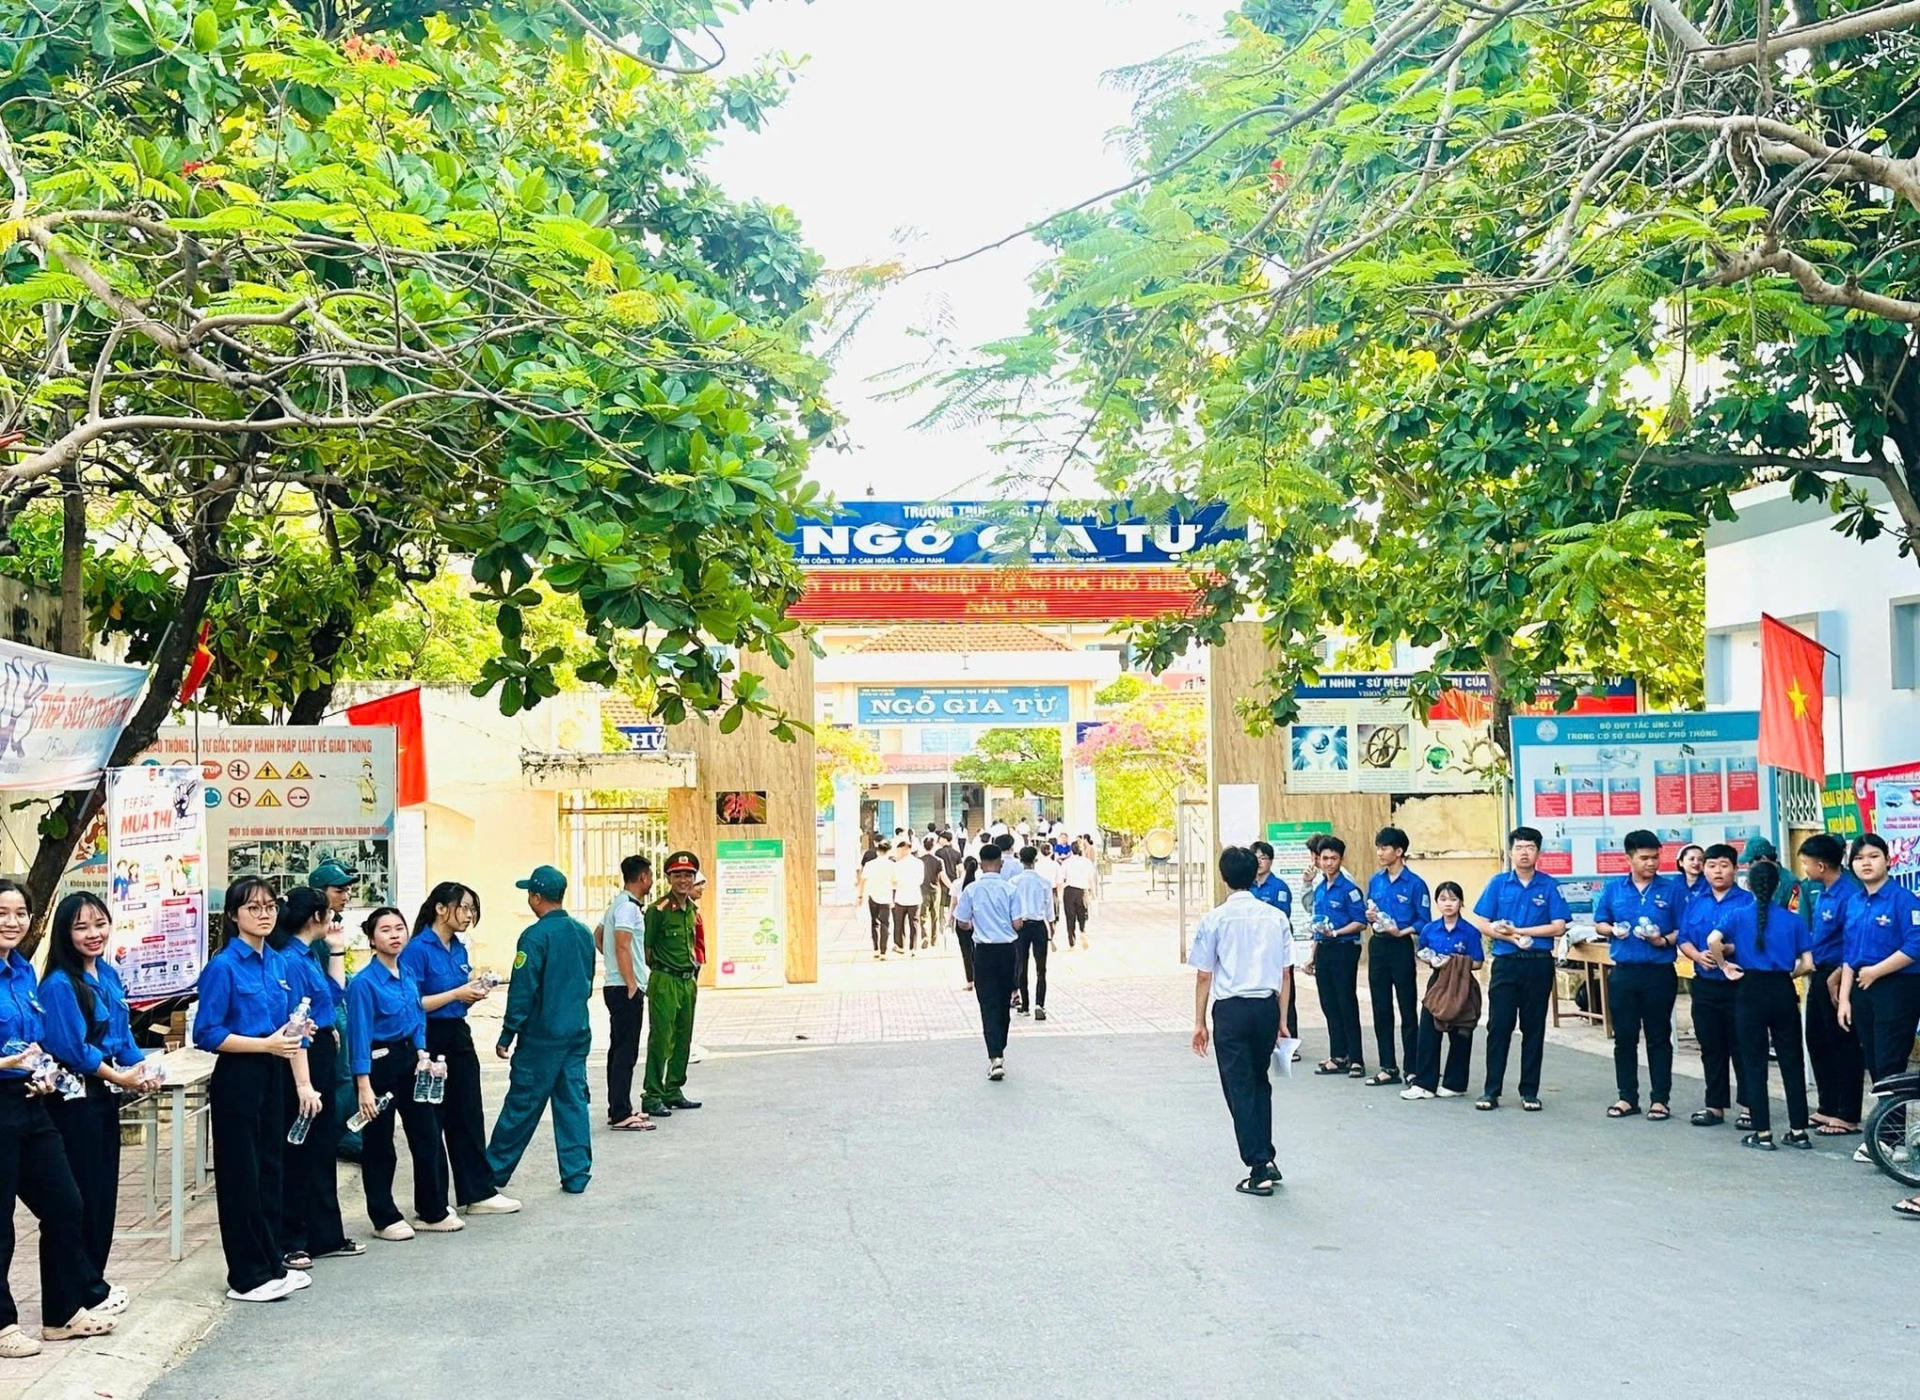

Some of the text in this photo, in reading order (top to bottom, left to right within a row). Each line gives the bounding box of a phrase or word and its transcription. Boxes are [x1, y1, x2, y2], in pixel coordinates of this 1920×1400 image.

[803, 520, 1204, 561] NGÔ GIA TỰ
[1330, 676, 1357, 689] NHÌN
[1464, 675, 1487, 688] CỦA
[869, 695, 1058, 718] NGÔ GIA TỰ
[165, 737, 189, 753] THÔNG
[276, 736, 297, 753] PHÁP
[328, 739, 347, 753] GIAO
[348, 737, 373, 753] THÔNG
[1566, 733, 1595, 741] TRONG
[153, 809, 173, 830] THI
